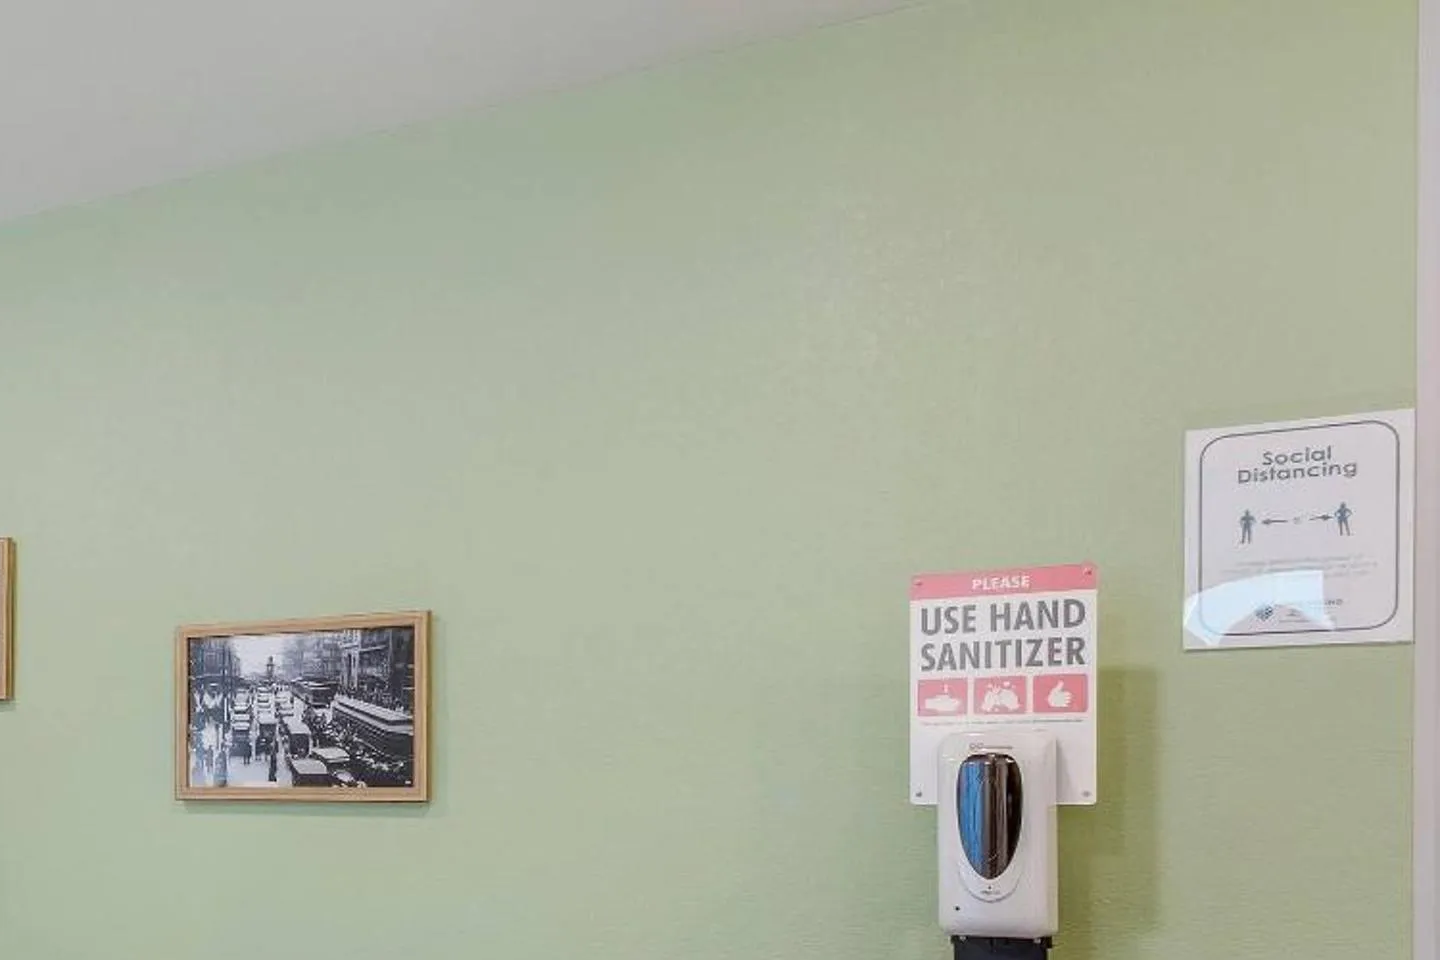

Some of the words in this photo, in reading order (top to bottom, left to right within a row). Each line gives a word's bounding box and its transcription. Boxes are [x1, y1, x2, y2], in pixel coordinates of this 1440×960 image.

[1262, 446, 1331, 466] Social
[1237, 461, 1358, 484] Distancing
[971, 575, 1031, 591] PLEASE
[921, 604, 977, 636] USE
[990, 598, 1086, 632] HAND
[921, 636, 1086, 672] SANITIZER
